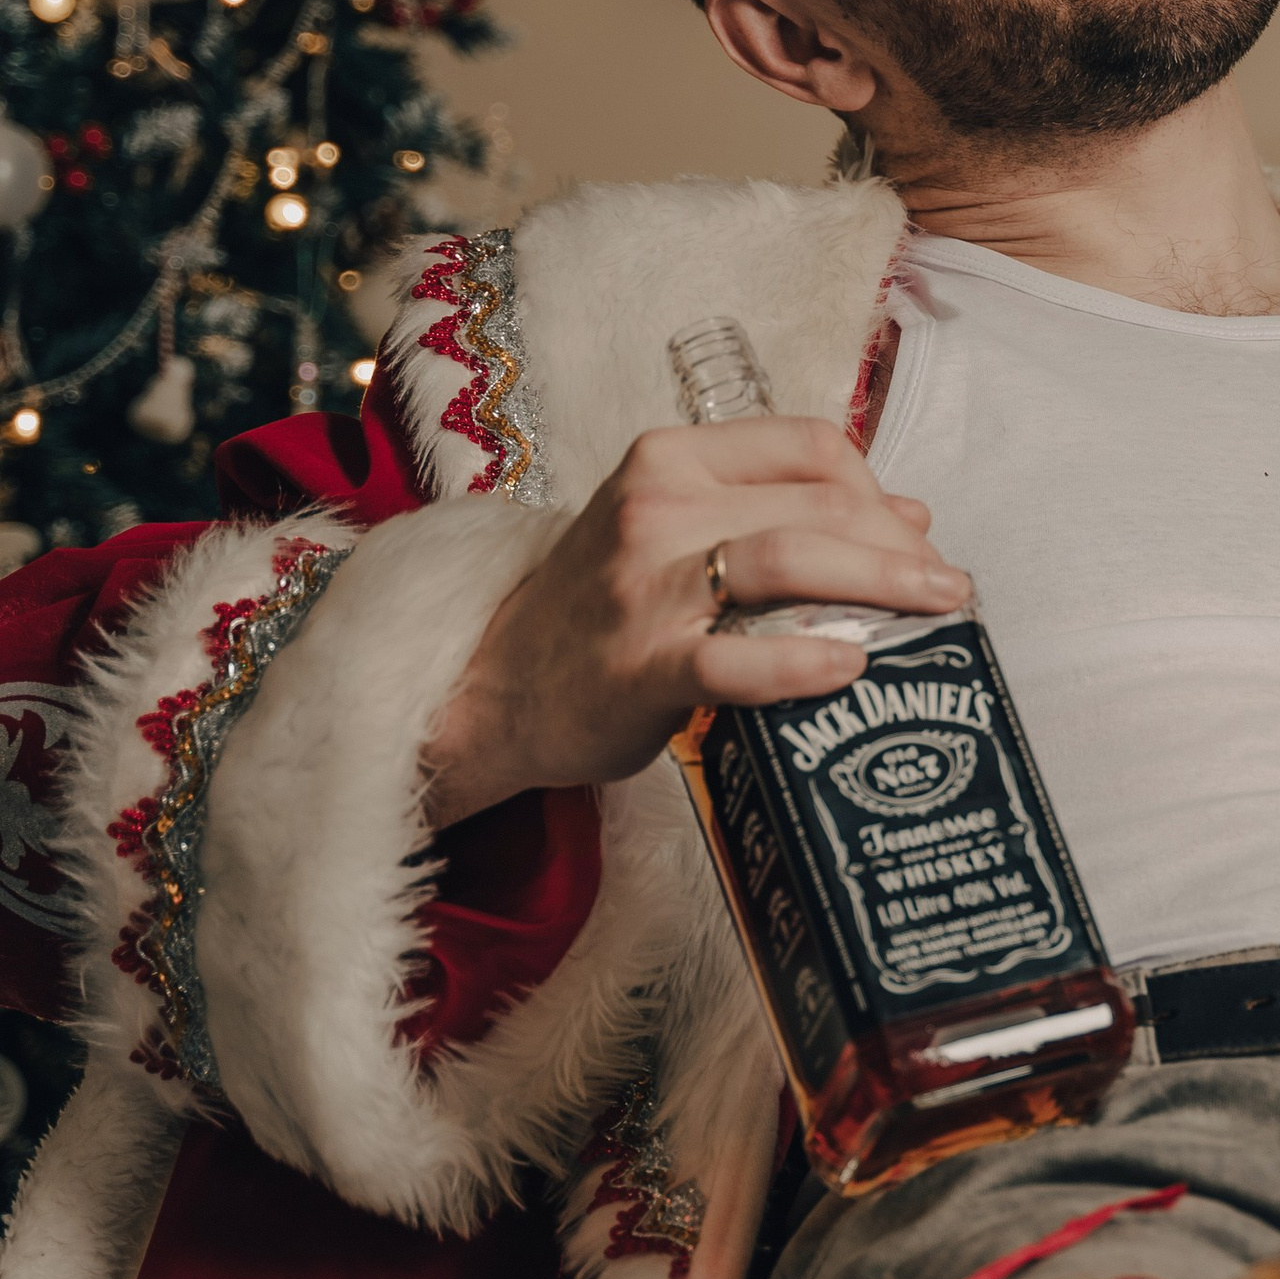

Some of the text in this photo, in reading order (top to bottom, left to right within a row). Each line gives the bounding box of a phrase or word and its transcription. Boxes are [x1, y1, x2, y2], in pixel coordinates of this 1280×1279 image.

[778, 678, 995, 772] JACK DANIEL'S
[857, 807, 997, 857] Tennessee
[875, 842, 1006, 894] WHISKEY
